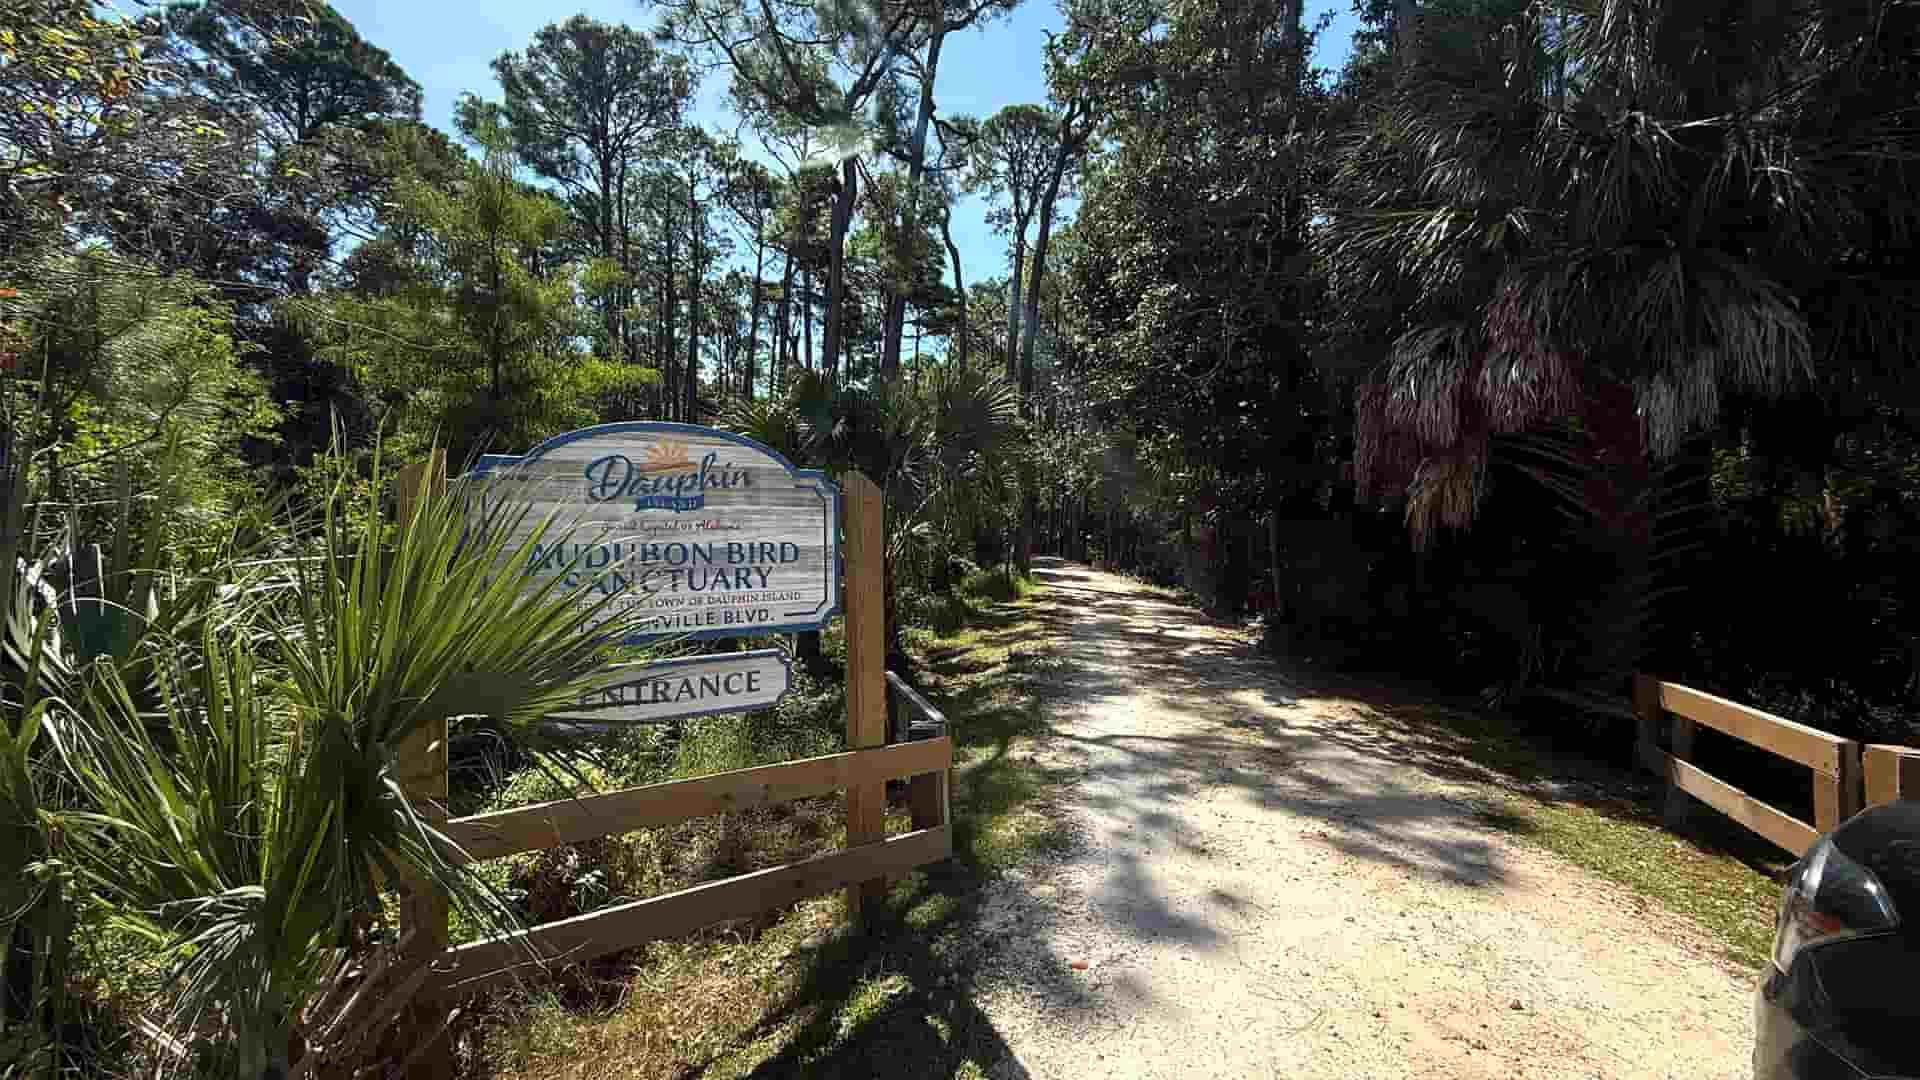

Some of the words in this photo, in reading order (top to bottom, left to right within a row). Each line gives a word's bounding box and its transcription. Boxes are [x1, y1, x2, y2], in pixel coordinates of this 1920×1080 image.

[584, 448, 754, 502] Dauphin
[528, 543, 713, 571] AUDUBON
[728, 542, 800, 564] BIRD
[707, 594, 756, 606] DAUPHIN
[757, 591, 801, 602] ISLAND
[723, 609, 776, 625] BLVD.
